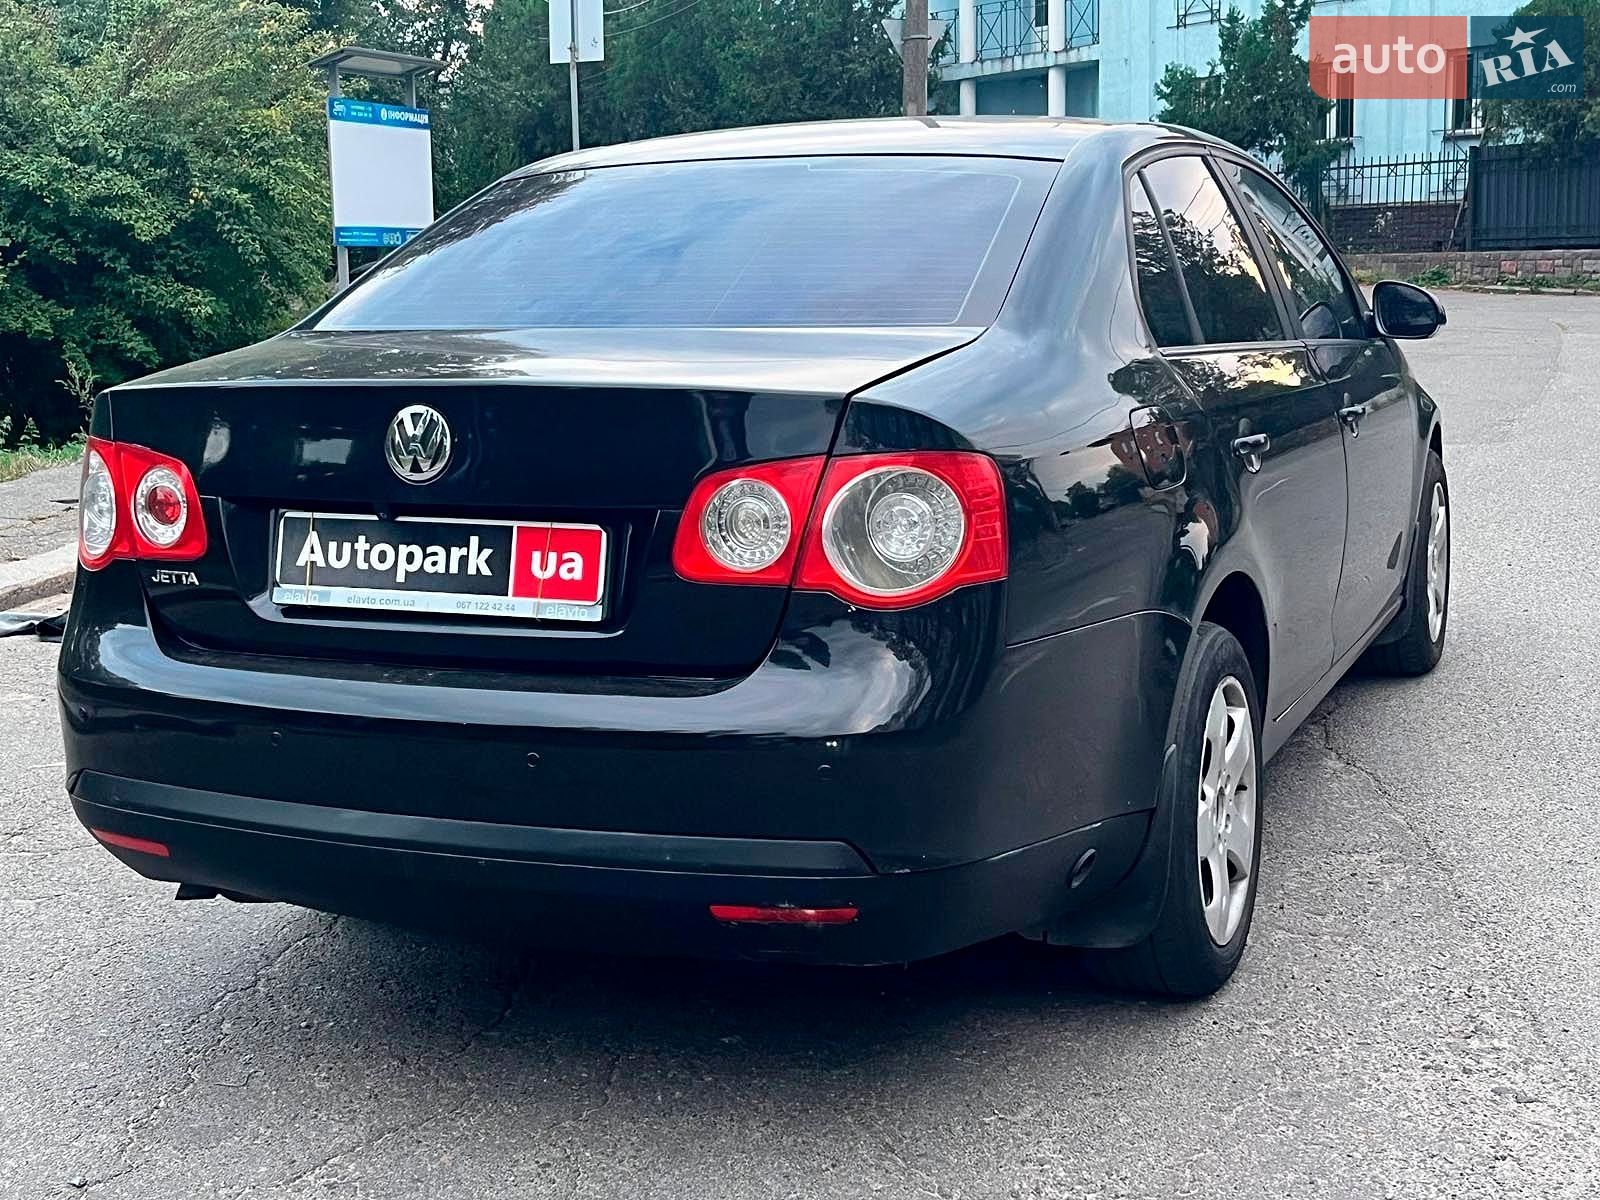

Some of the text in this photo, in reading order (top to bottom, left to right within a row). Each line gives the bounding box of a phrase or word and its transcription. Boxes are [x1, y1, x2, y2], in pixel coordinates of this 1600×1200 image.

[295, 529, 585, 583] Autopark ua
[151, 569, 200, 586] JETTA
[346, 595, 416, 607] elavto.com.ua
[456, 601, 516, 612] 067 122 42 44
[545, 605, 589, 618] elavto
